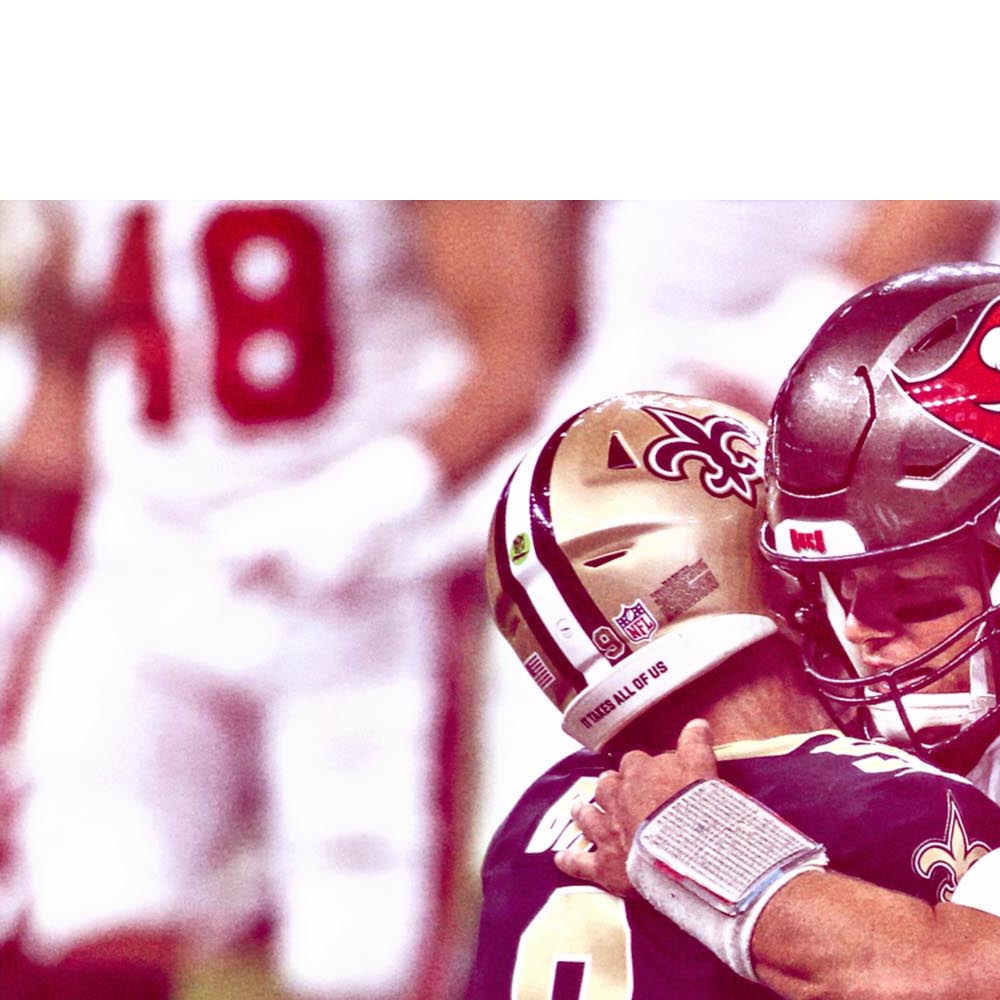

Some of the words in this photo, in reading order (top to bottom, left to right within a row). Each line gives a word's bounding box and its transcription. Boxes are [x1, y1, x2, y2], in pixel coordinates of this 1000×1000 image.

[592, 626, 625, 660] 9
[626, 617, 654, 639] NFL
[586, 698, 616, 724] TAKES
[612, 686, 636, 706] ALL
[632, 672, 649, 690] OF
[647, 661, 668, 679] US
